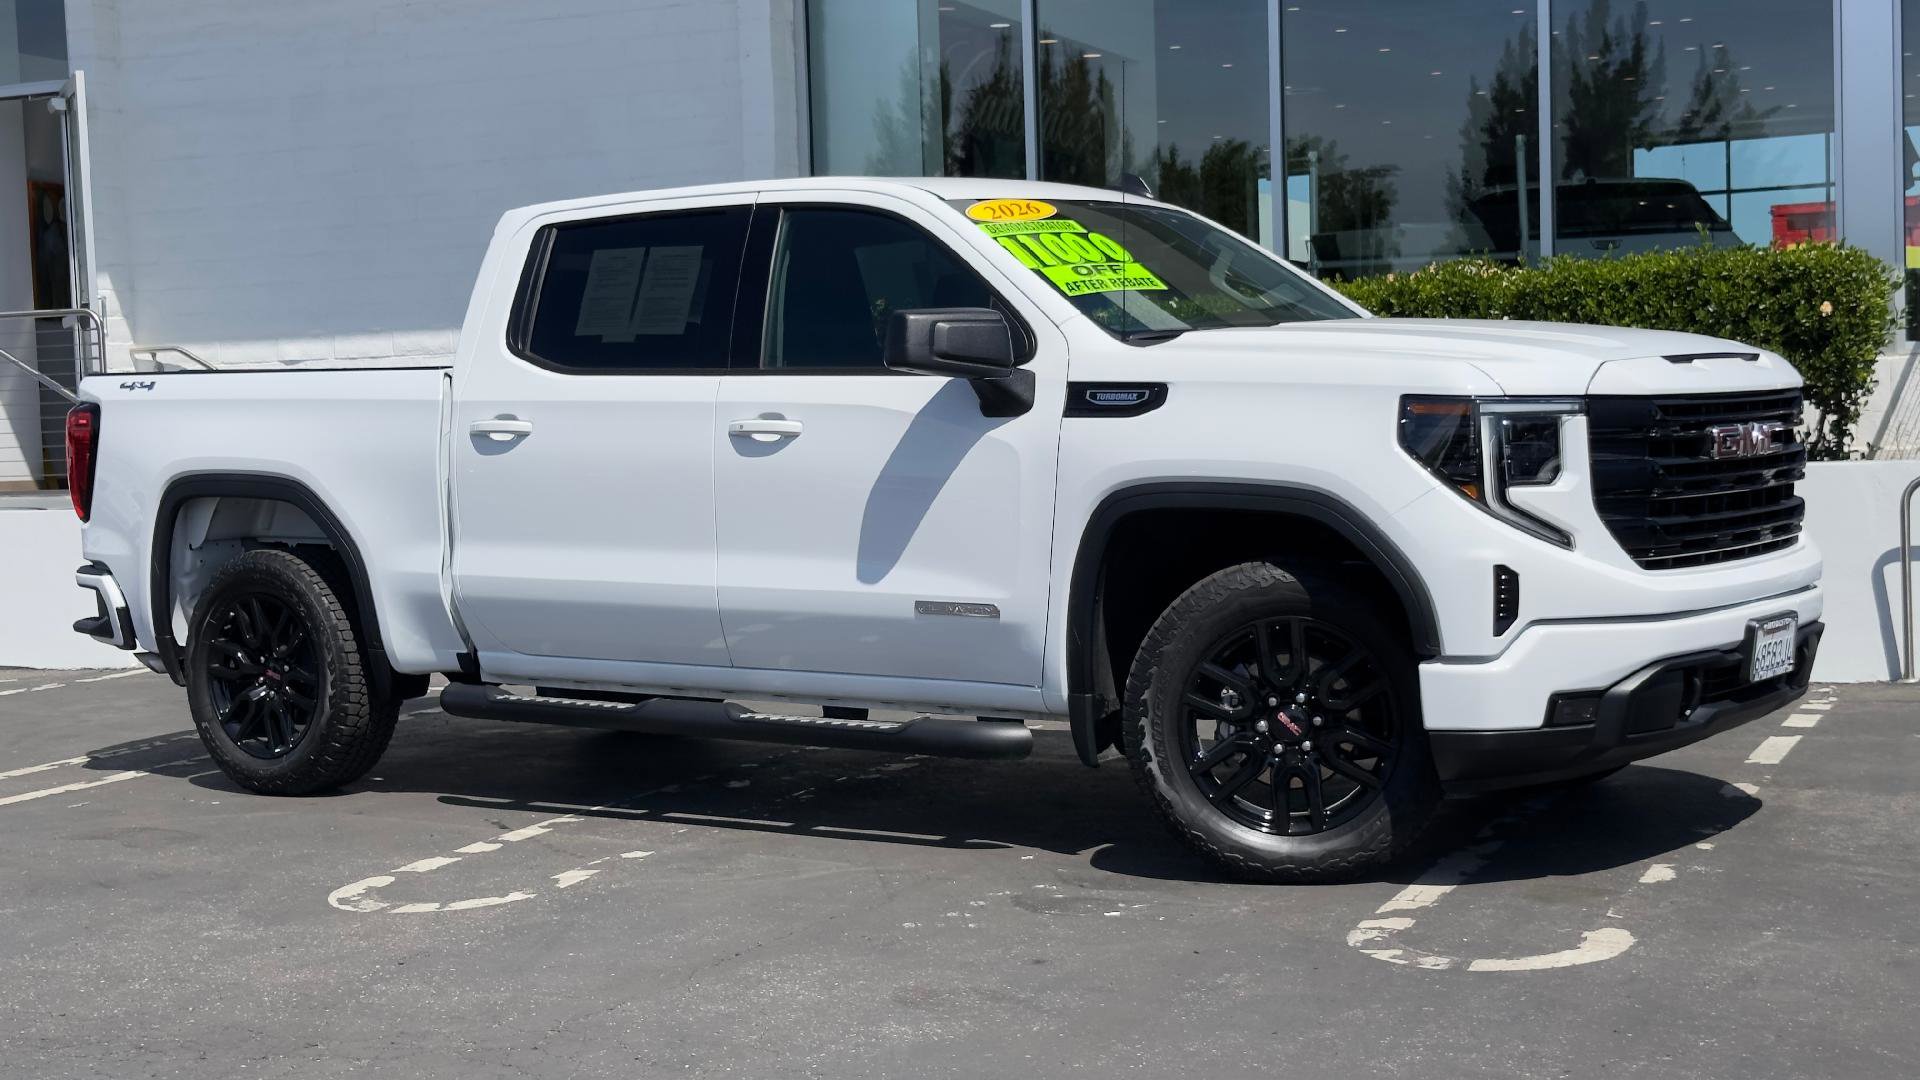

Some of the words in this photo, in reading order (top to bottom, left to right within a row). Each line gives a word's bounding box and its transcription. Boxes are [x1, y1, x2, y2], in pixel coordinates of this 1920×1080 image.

[983, 202, 1041, 220] 2026
[984, 220, 1076, 234] DEMONSTRATOR
[996, 232, 1134, 270] 11000
[1071, 264, 1124, 277] OFF
[1064, 280, 1106, 293] AFTER
[1111, 277, 1159, 290] REBATE
[1096, 392, 1139, 401] TURBOMAX
[1708, 422, 1784, 460] GMC
